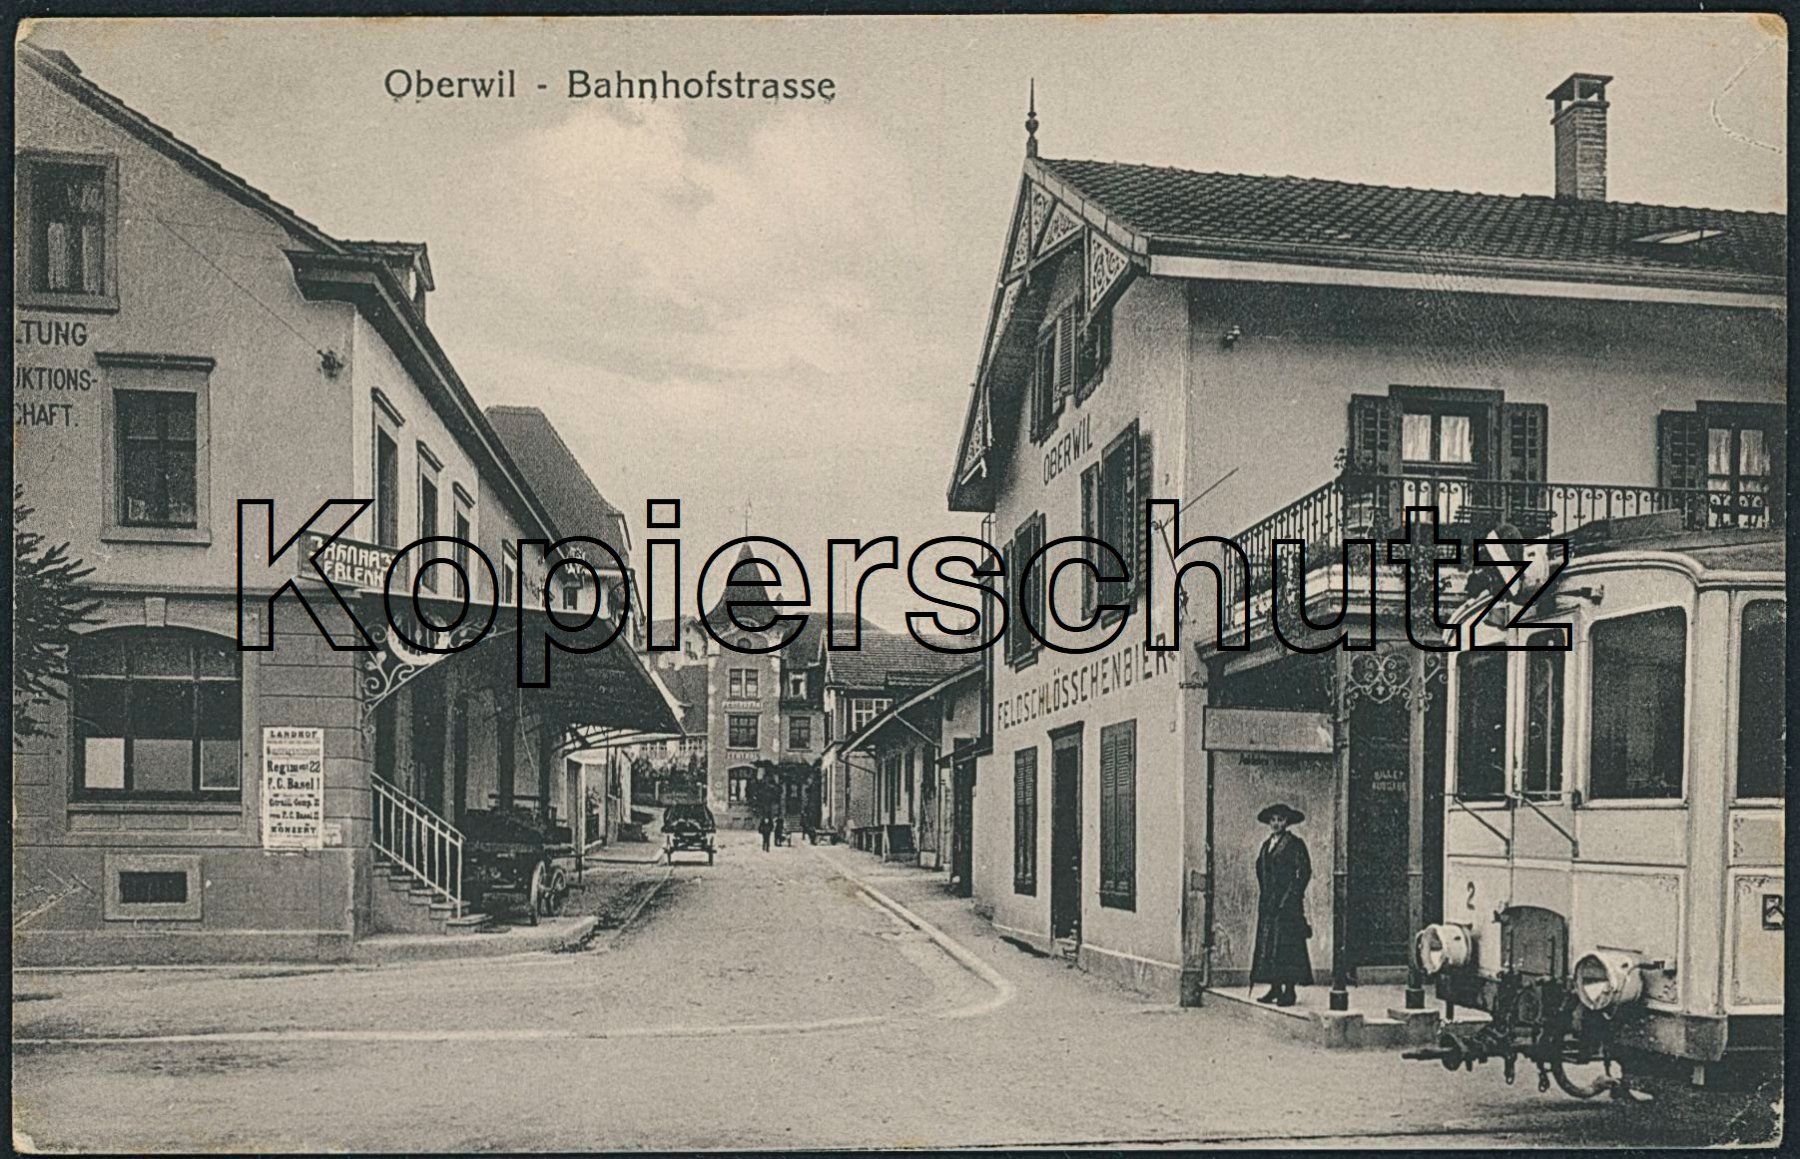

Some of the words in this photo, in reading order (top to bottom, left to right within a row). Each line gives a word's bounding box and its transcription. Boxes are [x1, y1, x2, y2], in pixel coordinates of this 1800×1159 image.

[1043, 412, 1093, 486] OBERWIL
[998, 632, 1168, 730] FELDSCHLÖSSCHENBIER
[309, 760, 320, 773] 22
[287, 777, 314, 790] Basel
[1467, 881, 1475, 910] 2
